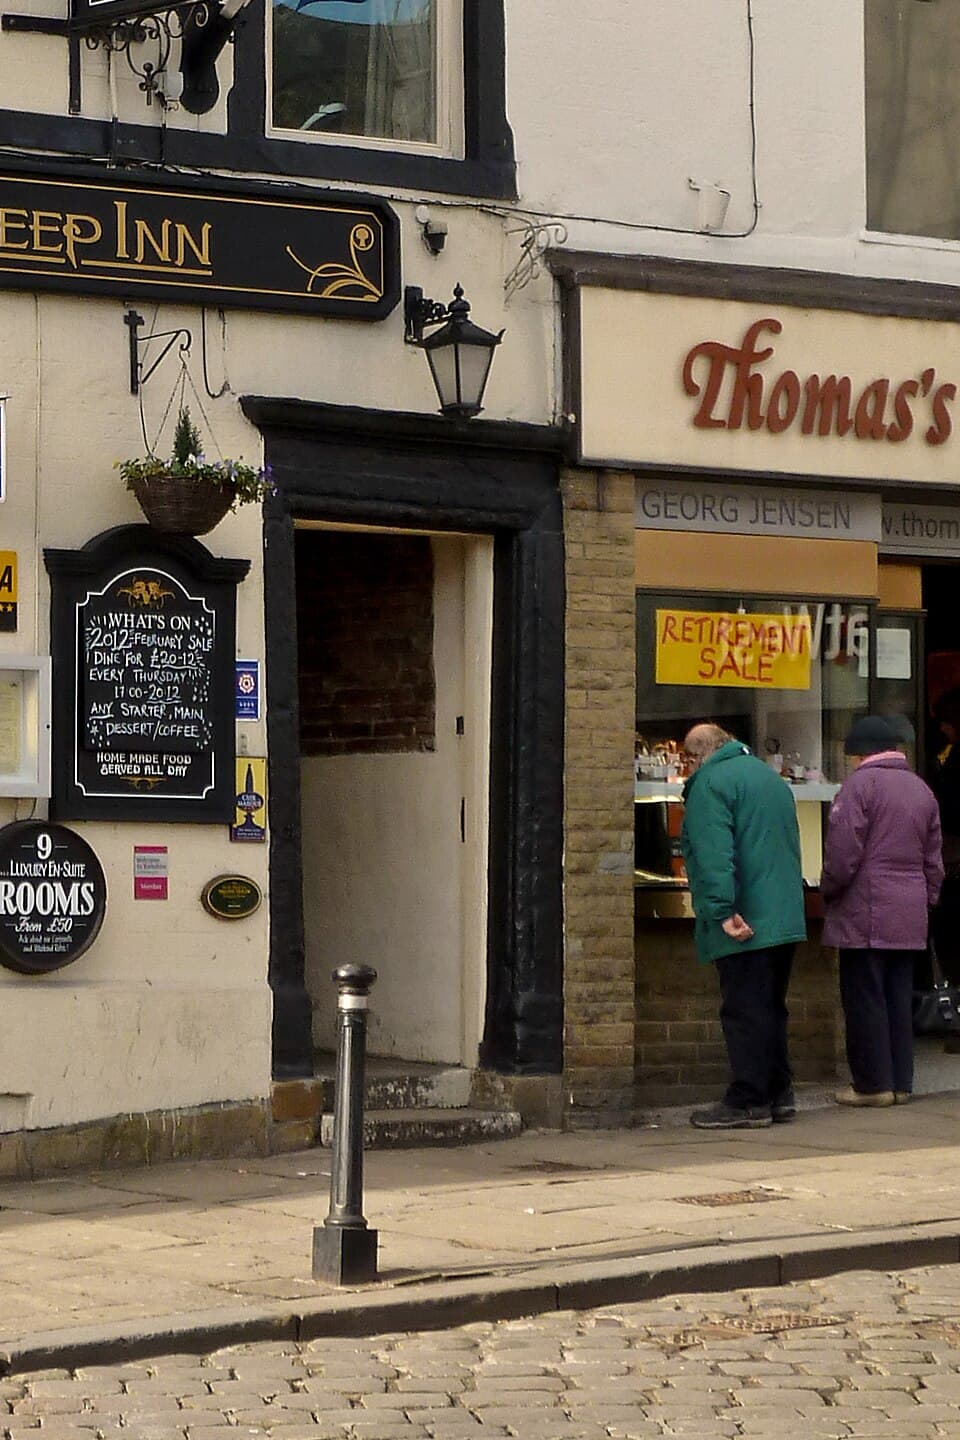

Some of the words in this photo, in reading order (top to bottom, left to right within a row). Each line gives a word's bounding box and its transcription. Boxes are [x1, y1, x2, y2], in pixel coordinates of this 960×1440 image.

[113, 200, 212, 267] INN
[682, 317, 958, 445] Thomas's
[641, 490, 738, 523] GEORG
[749, 496, 851, 530] JENSEN
[108, 612, 165, 630] WHAT'S
[170, 615, 191, 630] ON
[89, 627, 132, 651] 2012
[188, 635, 213, 652] SALE
[662, 615, 809, 654] RETIREMENT
[94, 651, 121, 666] DINE
[125, 651, 144, 667] FOR
[698, 651, 774, 684] SALE
[89, 667, 124, 683] EVERY
[133, 669, 187, 684] THURSDAY
[90, 701, 114, 716] ANY
[96, 752, 126, 763] HOME
[129, 753, 159, 764] MADE
[163, 754, 192, 765] FOOD
[100, 763, 140, 776] SERVED
[144, 764, 164, 775] ALL
[167, 765, 188, 777] DAY
[36, 833, 52, 860] 9
[15, 916, 42, 933] From
[46, 917, 73, 933] £50
